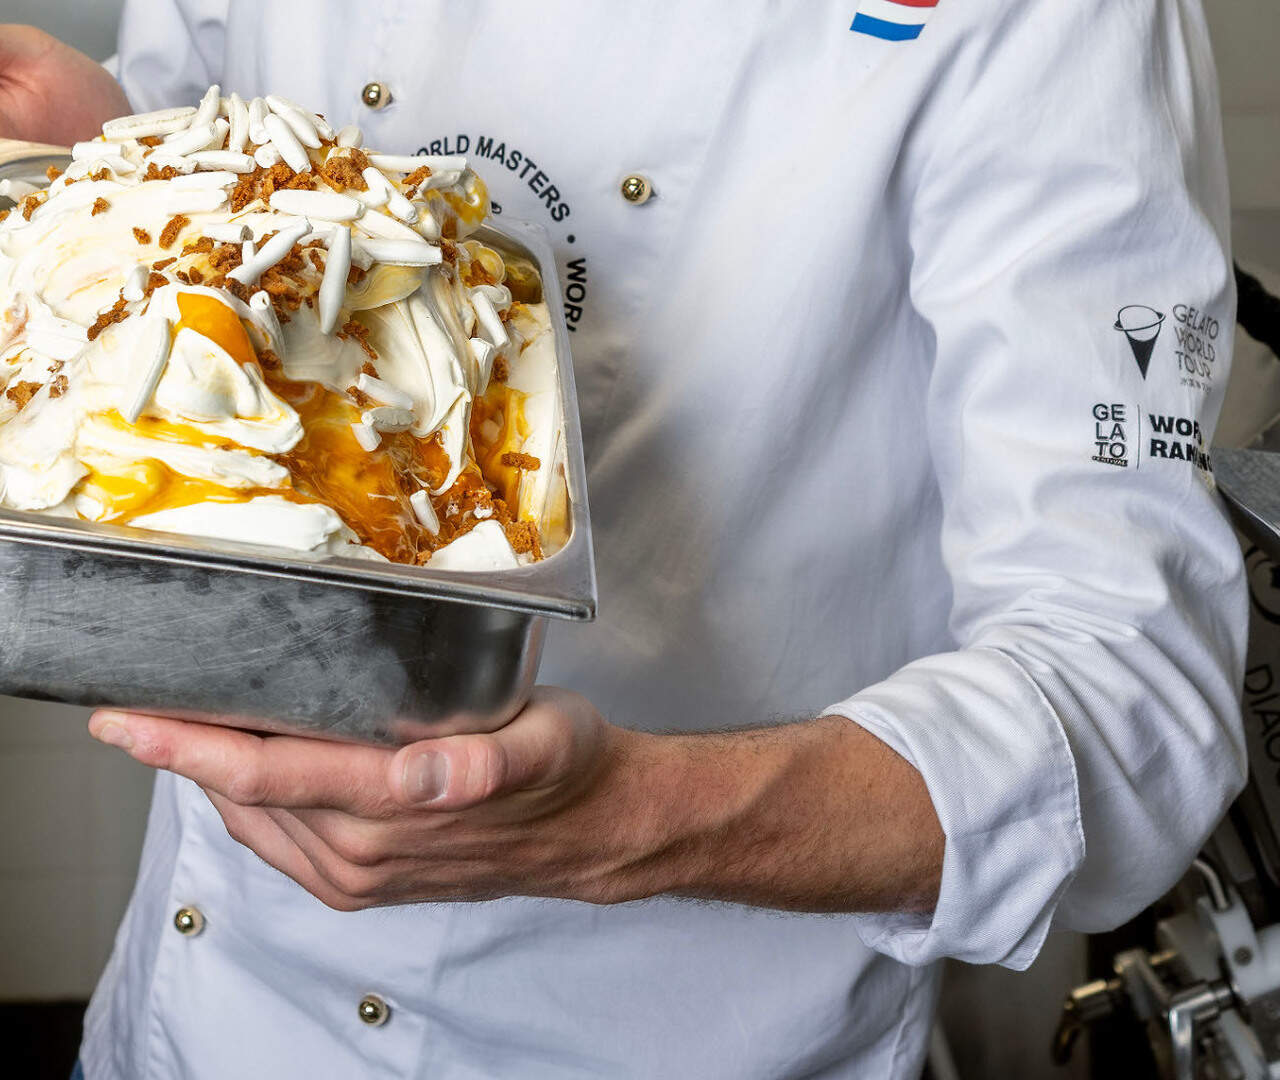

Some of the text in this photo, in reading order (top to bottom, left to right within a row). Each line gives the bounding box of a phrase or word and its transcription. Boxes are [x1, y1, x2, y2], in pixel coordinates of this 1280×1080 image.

[410, 134, 570, 222] RLD MASTERS
[564, 258, 587, 332] WOR
[1173, 304, 1219, 340] GELATO
[1174, 326, 1215, 362] WORLD
[1174, 350, 1212, 380] TOUR
[1092, 403, 1126, 422] GE
[1095, 422, 1126, 441] LA
[1094, 441, 1126, 458] TO
